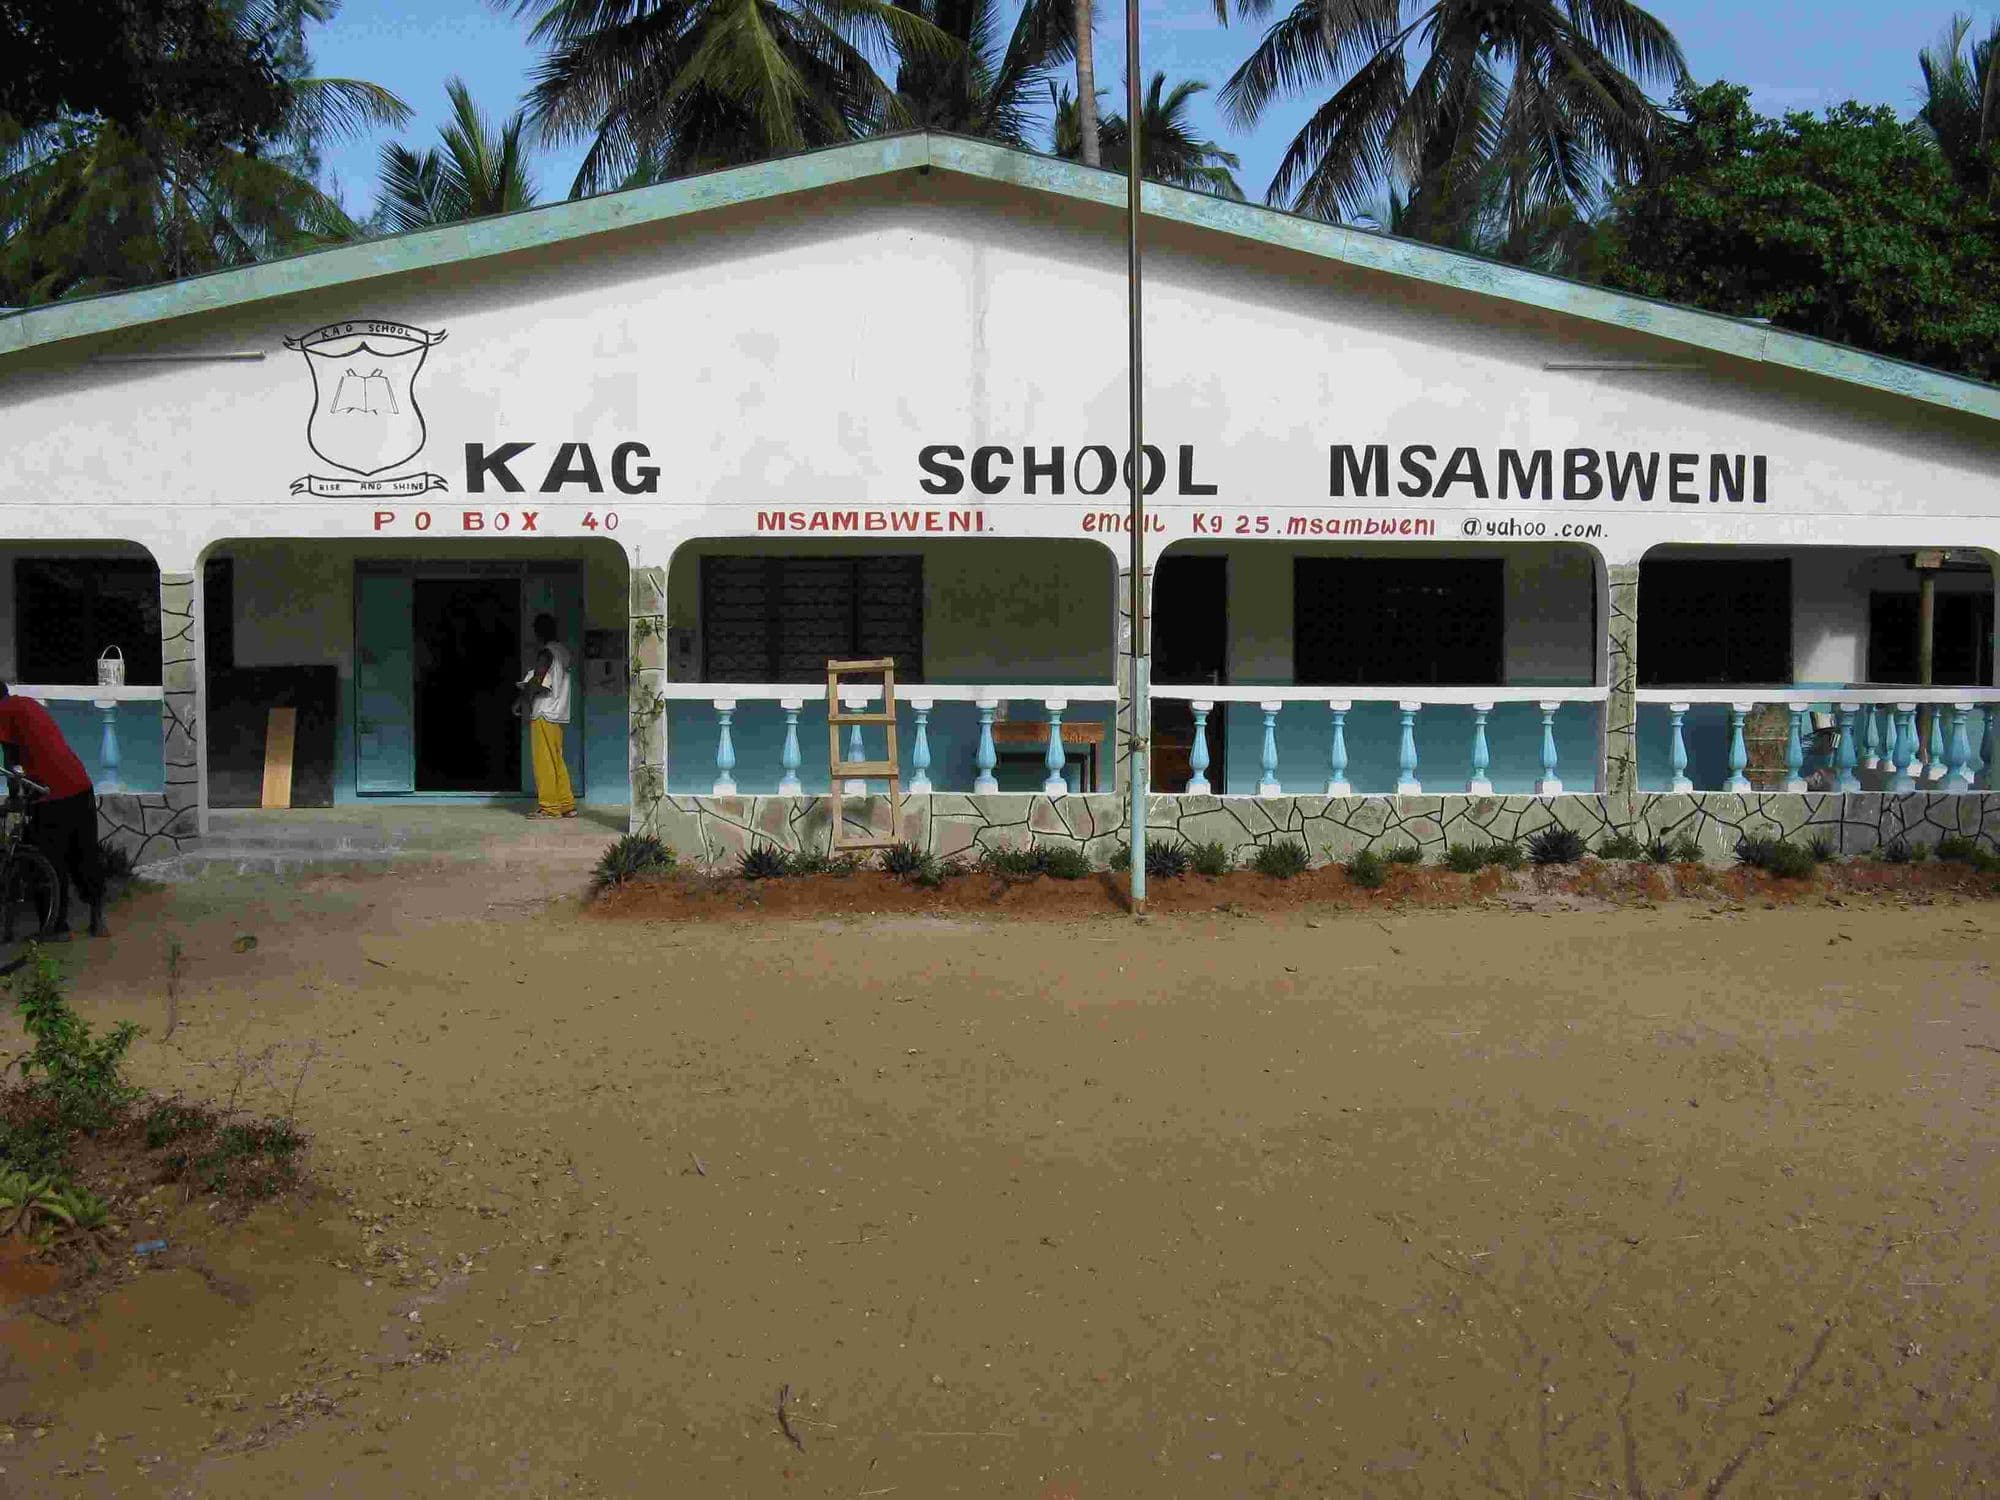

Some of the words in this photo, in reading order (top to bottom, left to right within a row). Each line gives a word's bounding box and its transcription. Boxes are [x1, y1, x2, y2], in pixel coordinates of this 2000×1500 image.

[368, 324, 411, 337] SCHOOL
[465, 442, 661, 494] KAG
[918, 444, 1218, 495] SCHOOL
[1329, 444, 1768, 504] MSAMBWENI
[360, 482, 382, 490] AND
[393, 482, 424, 490] SHINE
[374, 511, 395, 531] P
[462, 511, 539, 531] BOX
[581, 511, 619, 531] 40
[757, 510, 995, 533] MSAMBWENI.
